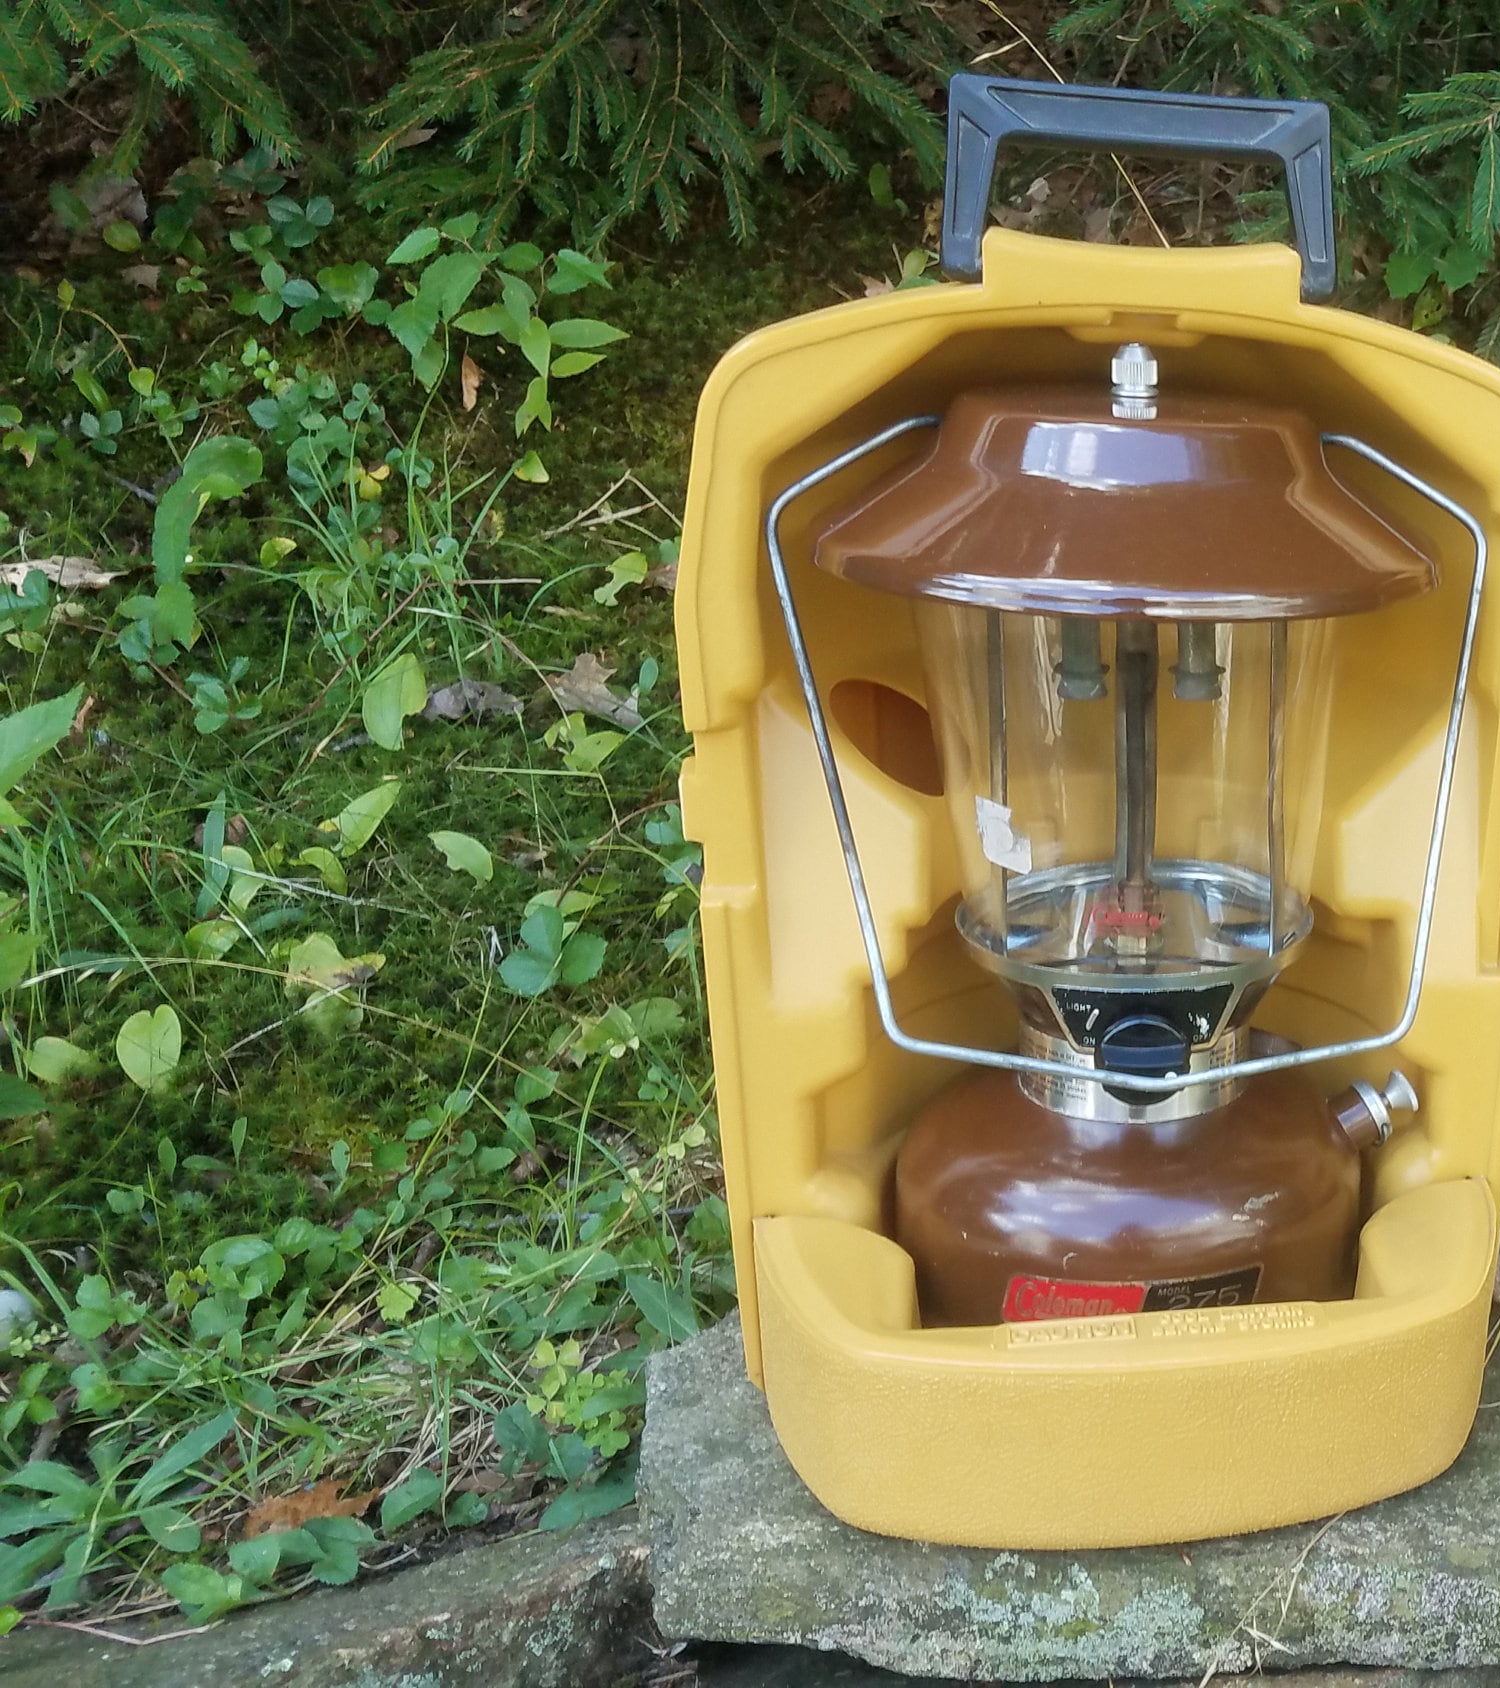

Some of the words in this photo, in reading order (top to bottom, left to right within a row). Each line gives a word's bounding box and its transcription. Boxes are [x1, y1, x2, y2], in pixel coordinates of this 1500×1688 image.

[1066, 1001, 1092, 1013] LIGHT
[1082, 1035, 1096, 1046] ON
[1157, 1285, 1191, 1297] MODEL
[1167, 1283, 1243, 1310] 275
[1015, 1281, 1114, 1320] Coleman
